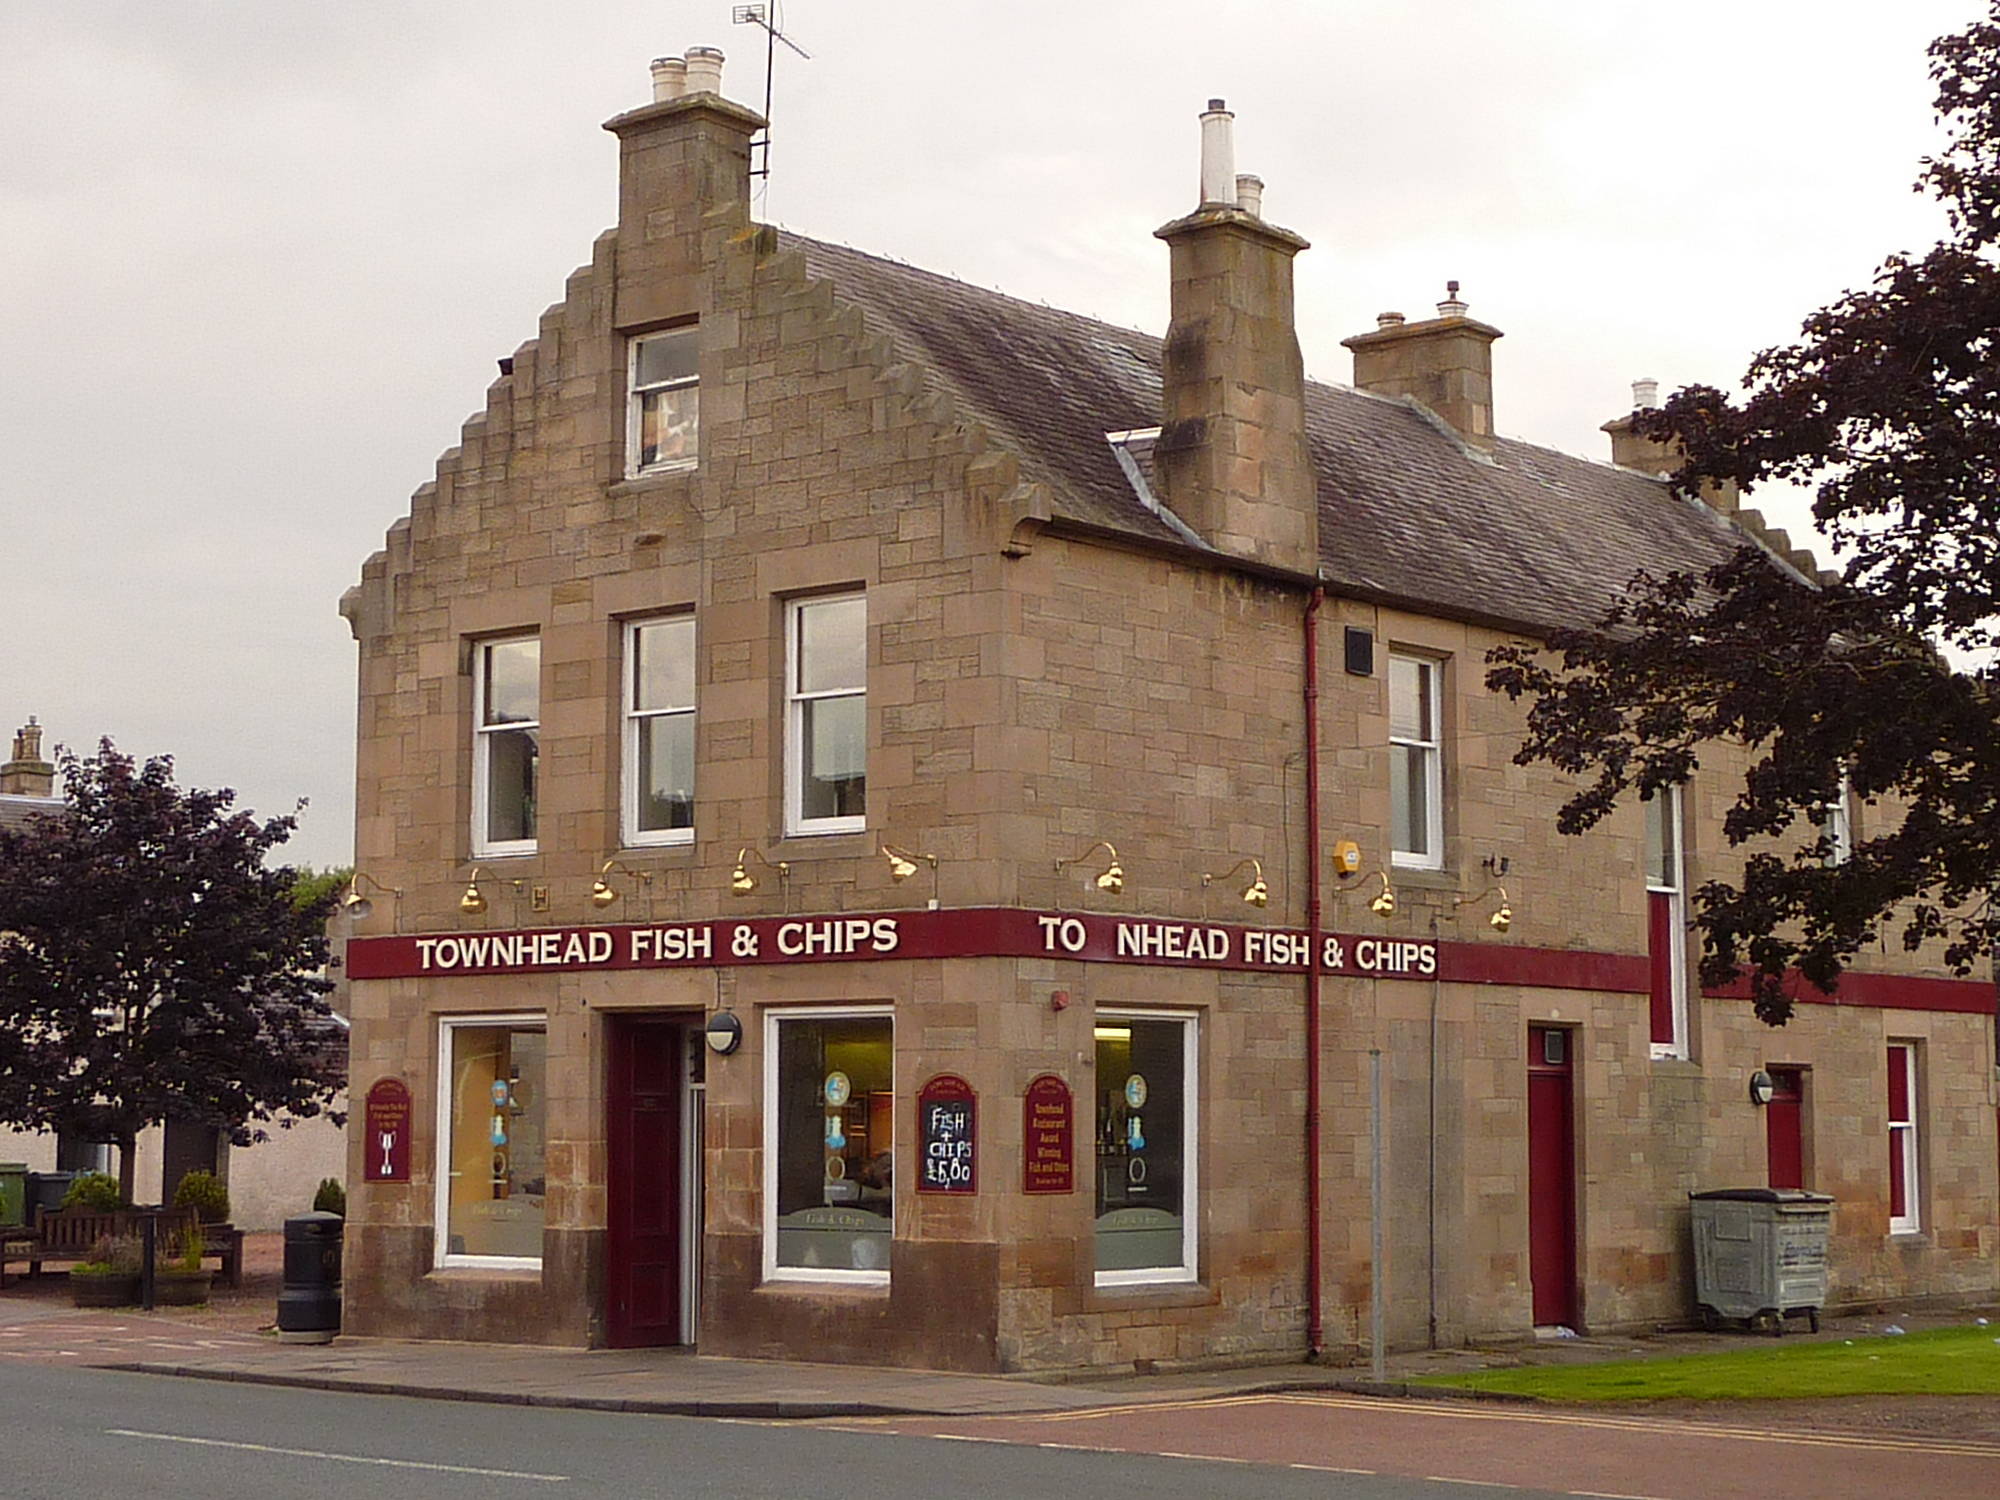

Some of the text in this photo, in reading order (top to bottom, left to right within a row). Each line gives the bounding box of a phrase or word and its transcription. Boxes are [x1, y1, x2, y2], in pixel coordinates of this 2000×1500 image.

[416, 918, 899, 970] TOWNHEAD FISH & CHIPS
[1037, 915, 1437, 975] TO NHEAD FISH & CHIPS
[931, 1106, 965, 1134] FISH
[929, 1140, 972, 1158] CHIPS
